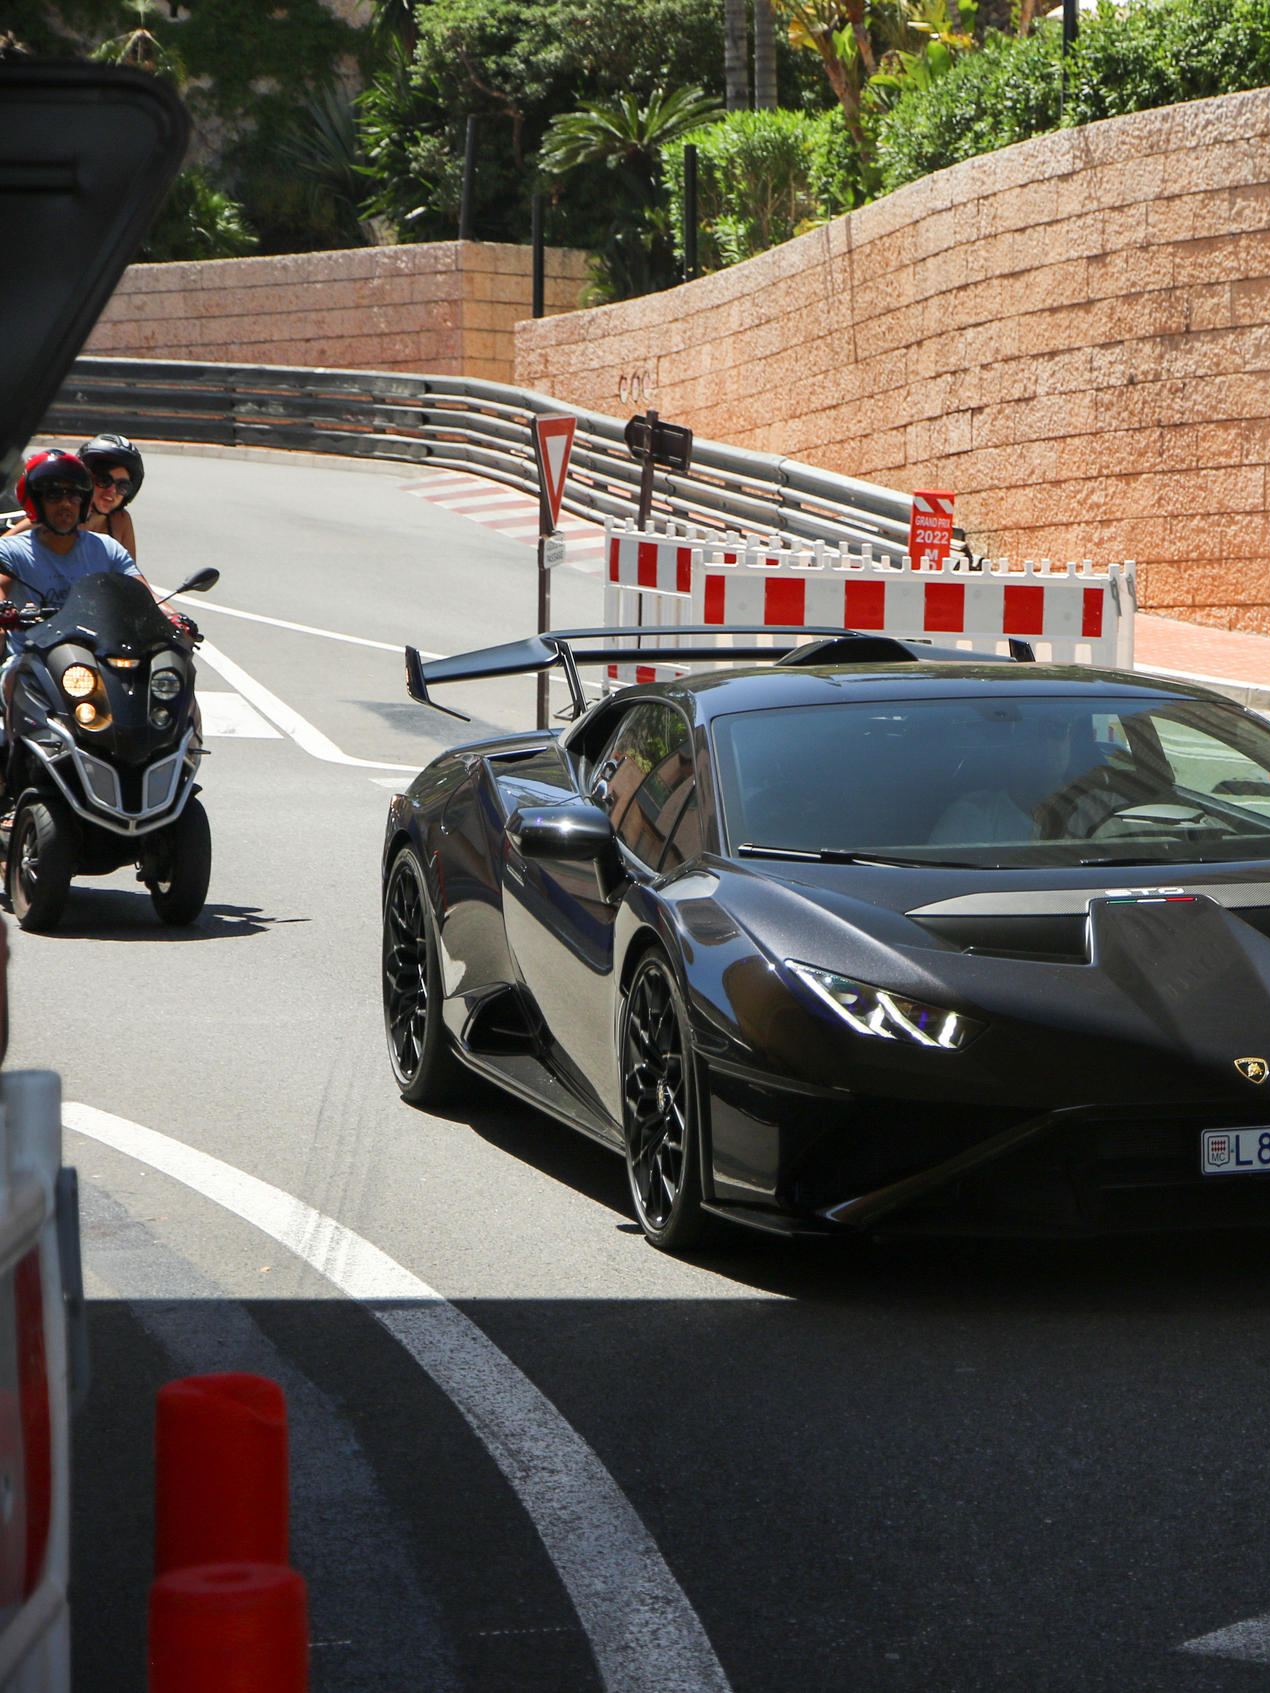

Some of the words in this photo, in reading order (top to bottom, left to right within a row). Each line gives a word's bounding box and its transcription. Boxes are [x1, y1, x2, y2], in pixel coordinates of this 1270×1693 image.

[915, 515, 937, 528] GRAND
[938, 518, 951, 529] PRIX
[915, 529, 949, 545] 2022
[925, 548, 939, 561] M
[1211, 1152, 1226, 1162] MC
